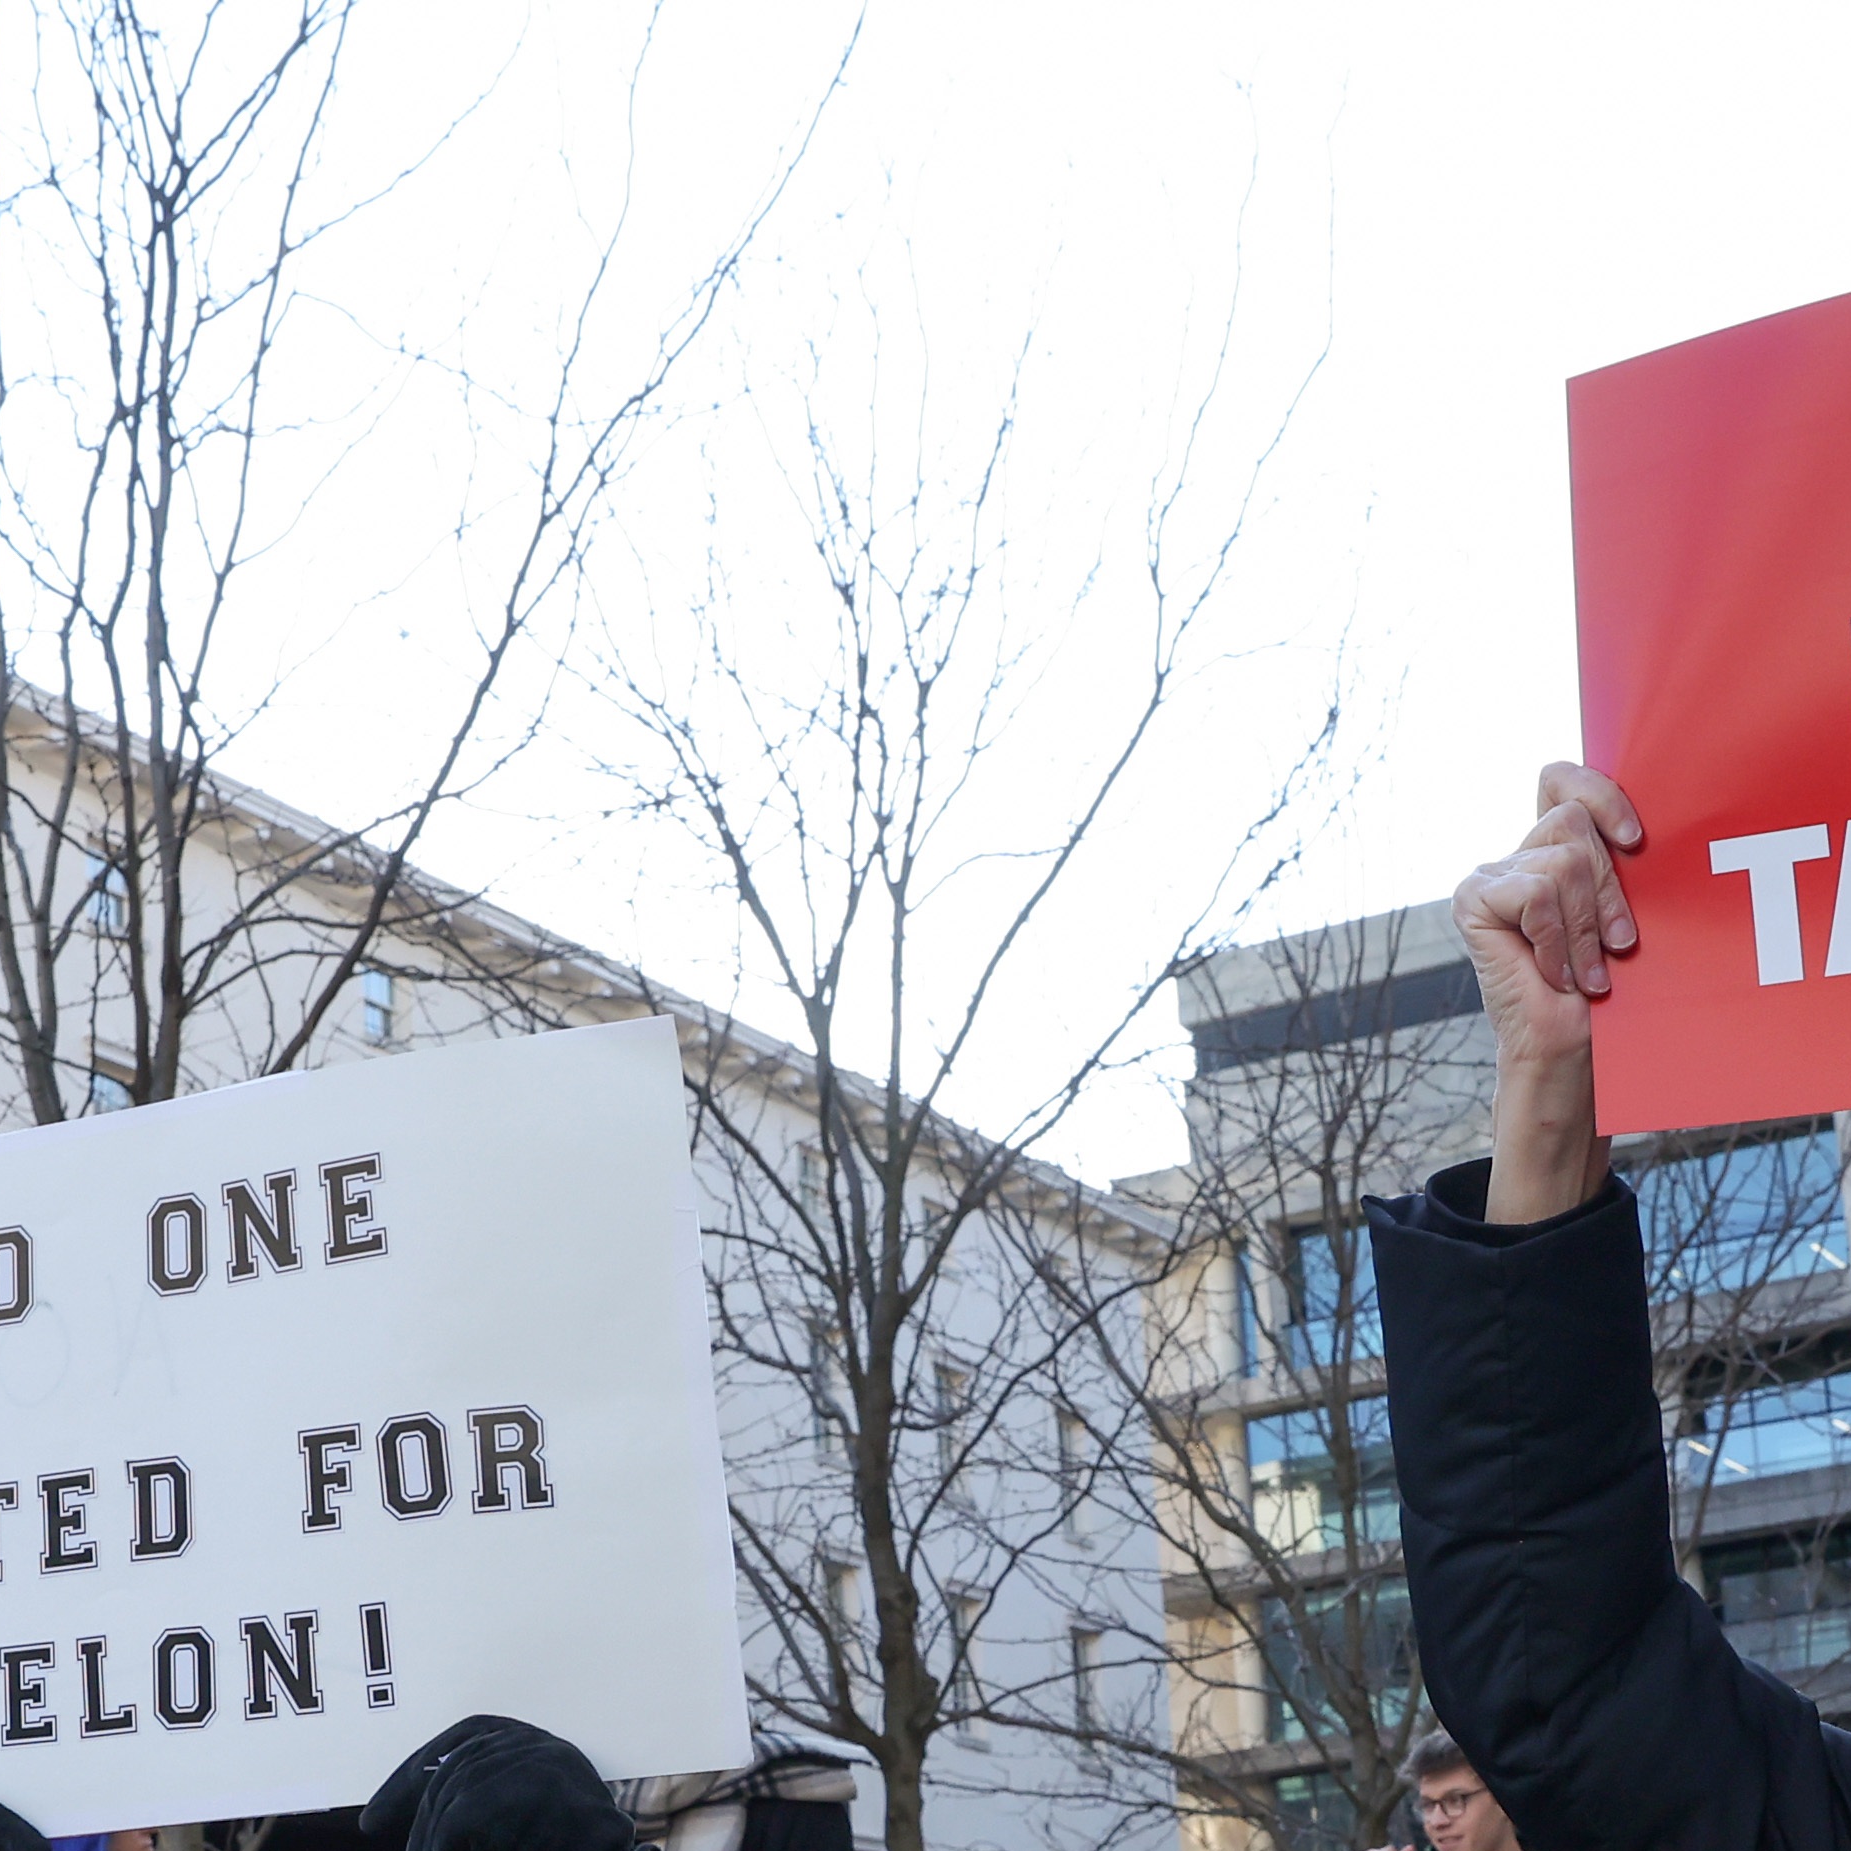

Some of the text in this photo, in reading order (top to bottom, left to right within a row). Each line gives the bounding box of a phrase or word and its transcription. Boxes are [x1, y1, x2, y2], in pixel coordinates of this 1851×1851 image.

[147, 1152, 389, 1297] ONE
[299, 1404, 554, 1533] FOR
[0, 1602, 397, 1747] ELON!
